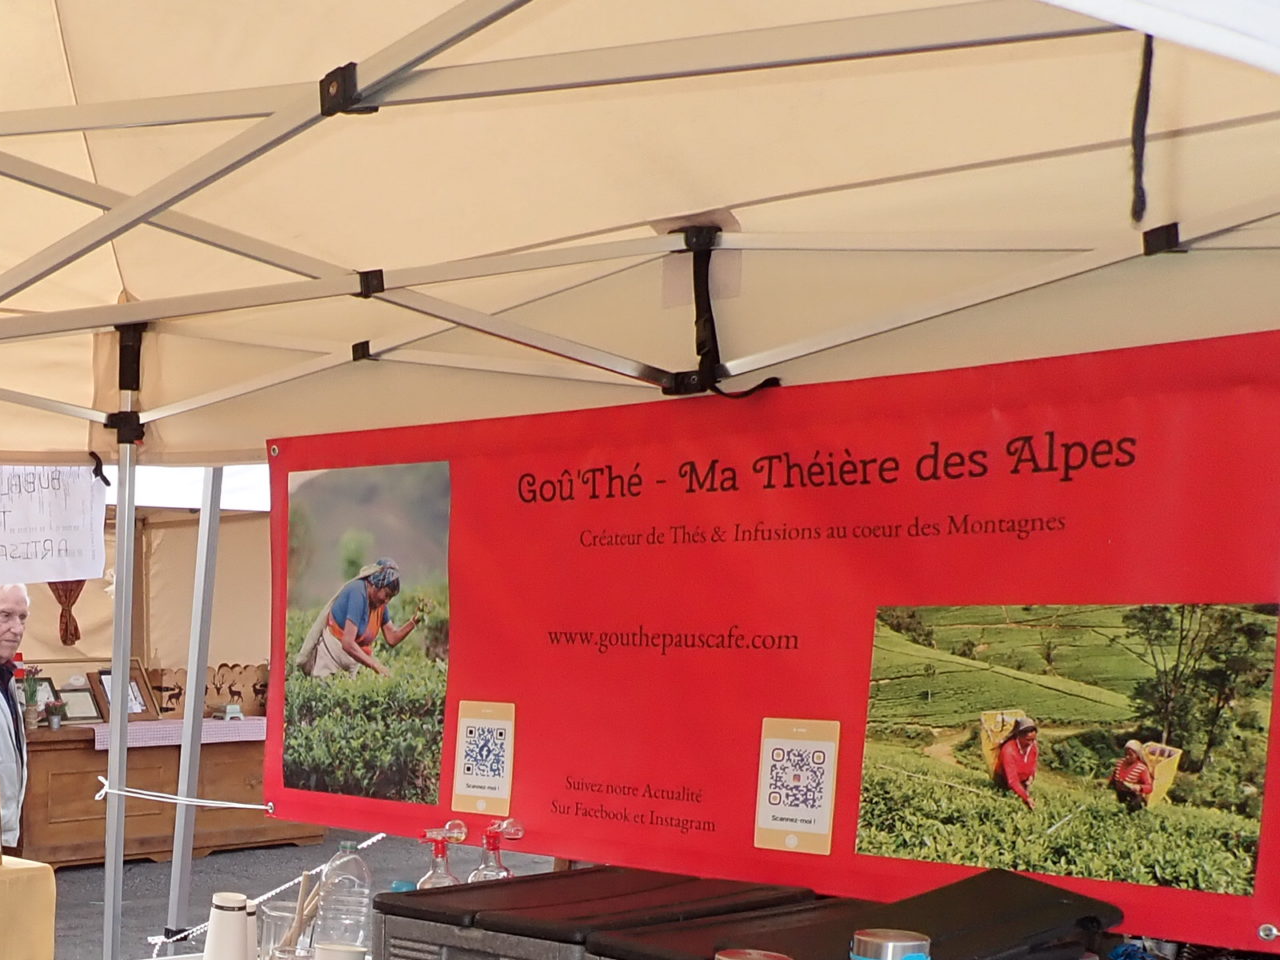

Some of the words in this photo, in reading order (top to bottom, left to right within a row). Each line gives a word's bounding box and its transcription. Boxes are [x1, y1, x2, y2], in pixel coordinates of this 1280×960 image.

[678, 459, 739, 493] Ma
[752, 449, 900, 490] Théière
[915, 442, 988, 481] des
[1006, 431, 1137, 482] Alpes
[579, 529, 643, 547] Créateur
[646, 526, 665, 545] de
[670, 525, 707, 544] Thés
[710, 526, 727, 543] &
[734, 521, 821, 542] Infusions
[826, 526, 847, 539] au
[852, 524, 902, 539] coeur
[907, 516, 941, 537] des
[947, 513, 1066, 541] Montagnes
[548, 625, 800, 655] www.gouthepauscafe.com
[565, 776, 603, 793] Suivez
[606, 783, 639, 797] notre
[642, 783, 703, 803] Actualité
[550, 799, 571, 815] Sur
[574, 802, 631, 823] Facebook
[633, 813, 645, 825] et
[649, 810, 717, 834] Instagram
